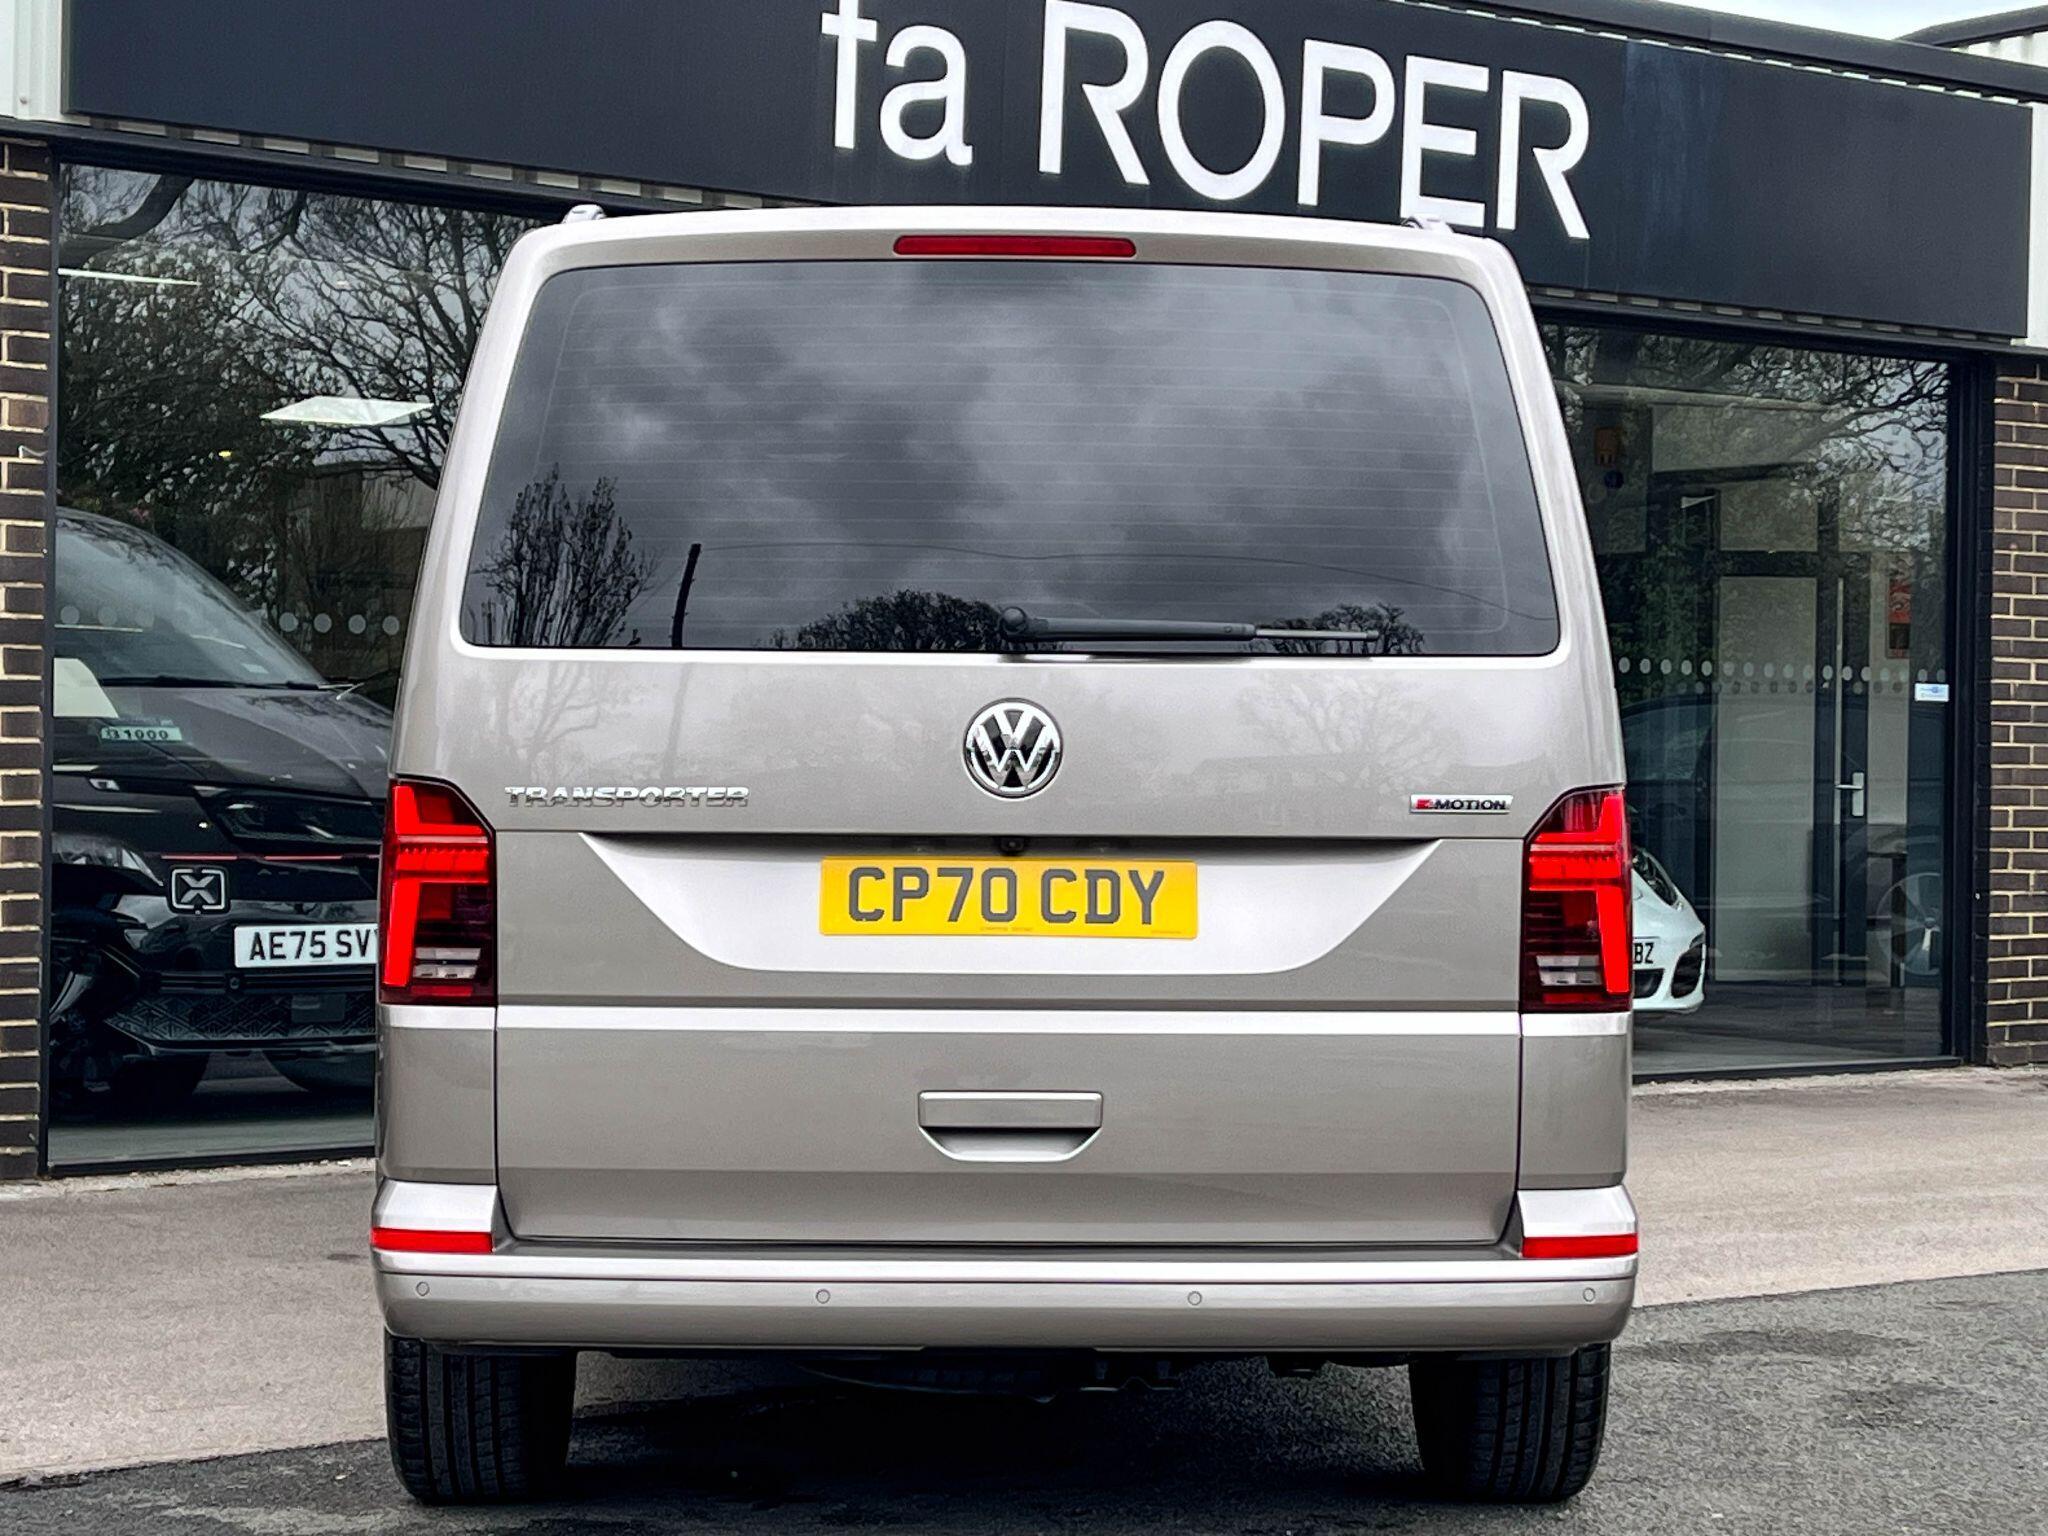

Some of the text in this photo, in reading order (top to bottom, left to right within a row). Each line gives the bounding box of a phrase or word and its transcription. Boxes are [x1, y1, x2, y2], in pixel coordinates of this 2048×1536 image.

[1038, 0, 1590, 241] ROPER
[505, 786, 749, 807] TRANSPORTER
[848, 867, 1165, 926] CP70 CDY
[249, 928, 378, 961] AE75 SV
